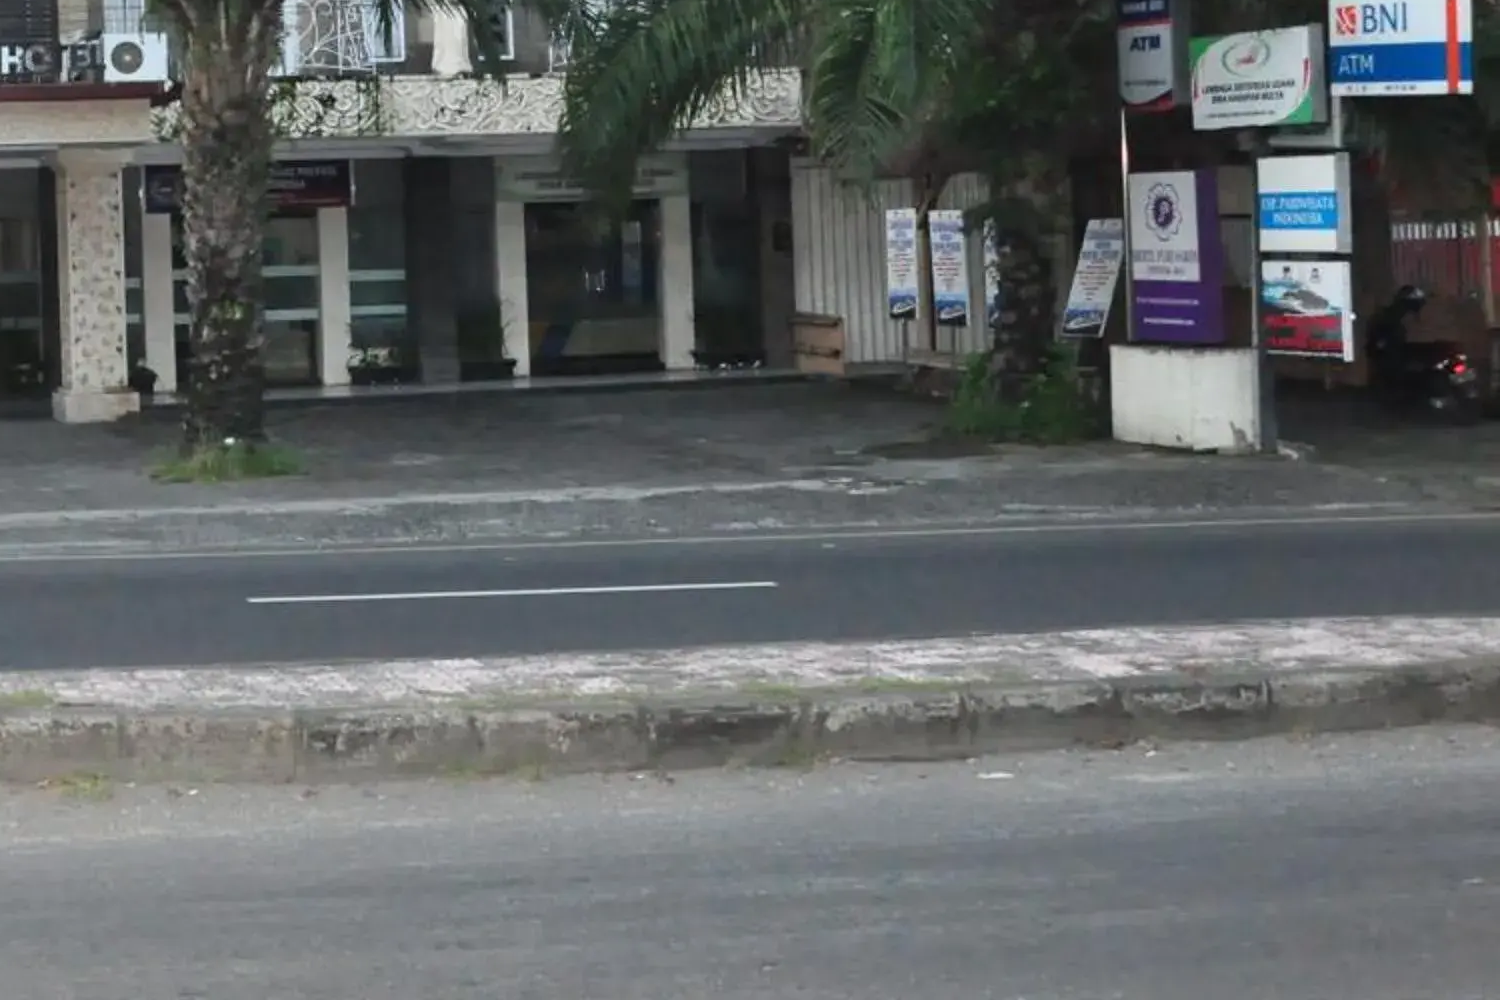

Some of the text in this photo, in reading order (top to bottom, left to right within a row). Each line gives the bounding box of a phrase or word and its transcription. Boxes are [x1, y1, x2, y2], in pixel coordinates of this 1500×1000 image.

[1362, 2, 1407, 33] BNI
[1129, 35, 1161, 51] ATM
[1338, 53, 1375, 75] ATM
